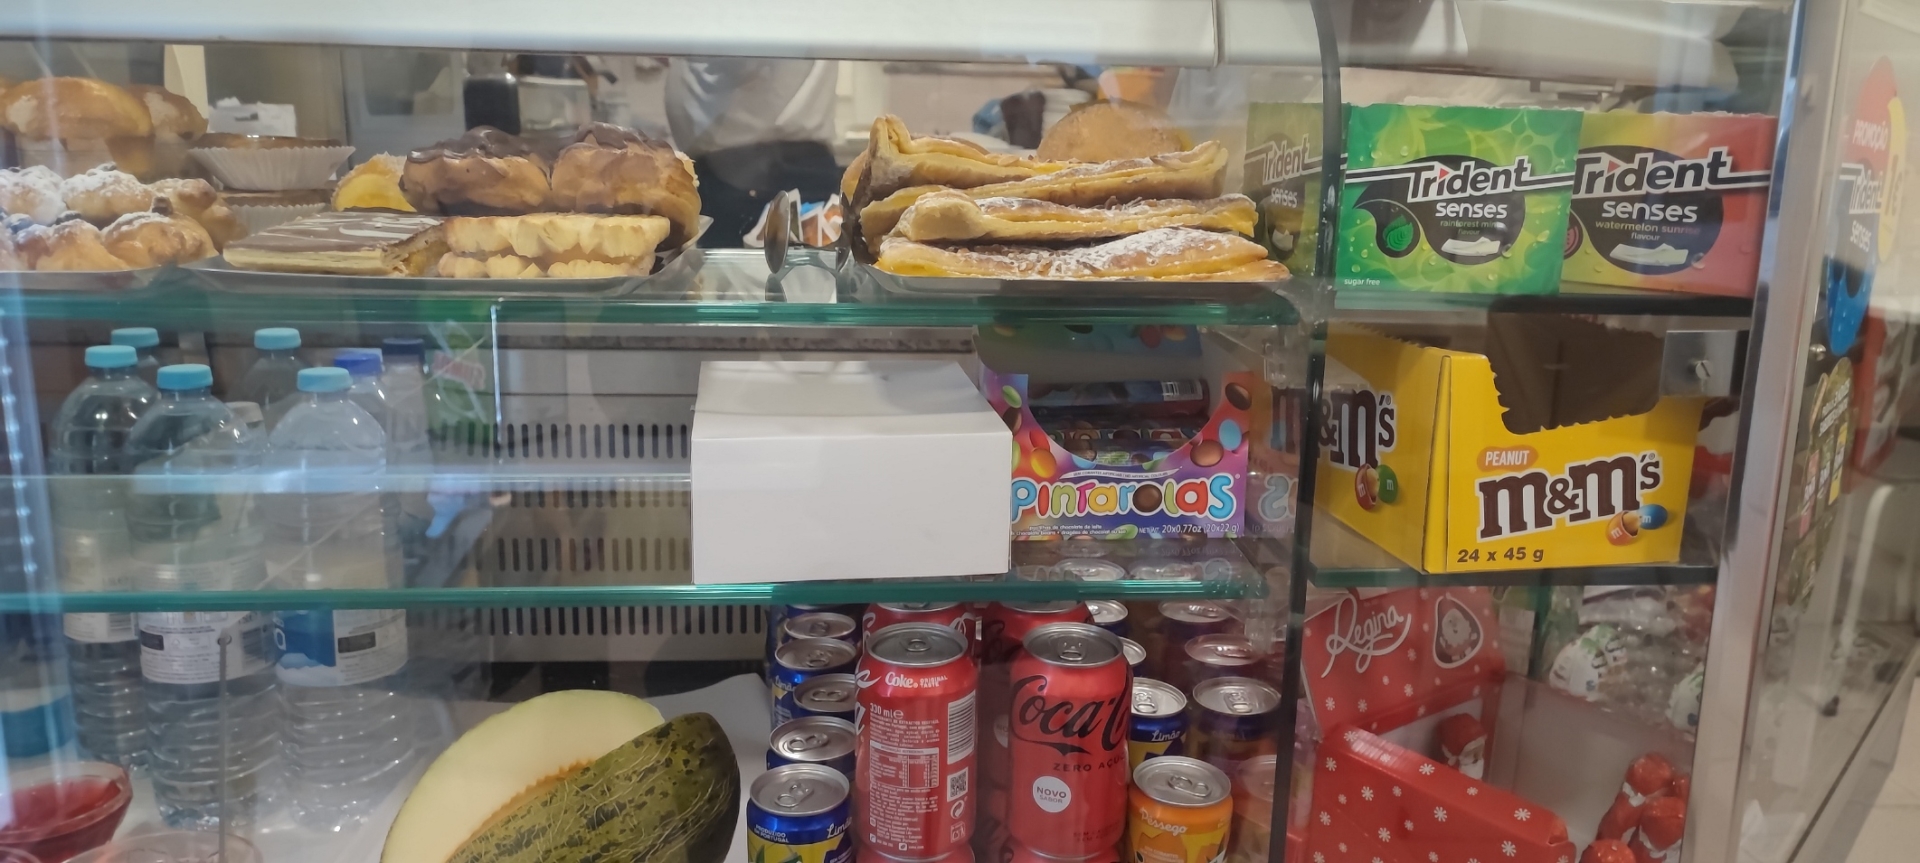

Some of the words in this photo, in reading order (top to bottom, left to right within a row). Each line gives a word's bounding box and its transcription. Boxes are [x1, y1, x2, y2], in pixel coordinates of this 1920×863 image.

[1262, 132, 1310, 186] Trident
[1407, 155, 1533, 203] Trident
[1572, 146, 1734, 199] Trident
[1271, 187, 1298, 209] senses
[1435, 201, 1508, 219] senses
[1601, 201, 1699, 223] senses
[1440, 219, 1480, 228] rainforest
[1595, 220, 1659, 232] watermelon
[1661, 224, 1701, 235] sunrise
[1631, 231, 1661, 241] flavour
[1344, 278, 1364, 287] sugar
[1365, 277, 1381, 285] free
[1485, 449, 1531, 467] PEANUT
[1162, 524, 1202, 534] 20x0.77oz
[1203, 523, 1230, 534] (20x22
[1231, 523, 1240, 534] g)
[1457, 547, 1480, 563] 24
[1486, 551, 1497, 562] x
[1504, 546, 1527, 561] 45
[1533, 549, 1544, 562] g
[1320, 592, 1413, 679] Regina
[885, 671, 913, 688] Coke
[869, 702, 881, 715] 330
[1150, 729, 1181, 742] Limão
[1053, 762, 1092, 772] ZERO
[1036, 786, 1067, 799] NOVO
[1040, 794, 1063, 804] SABOR
